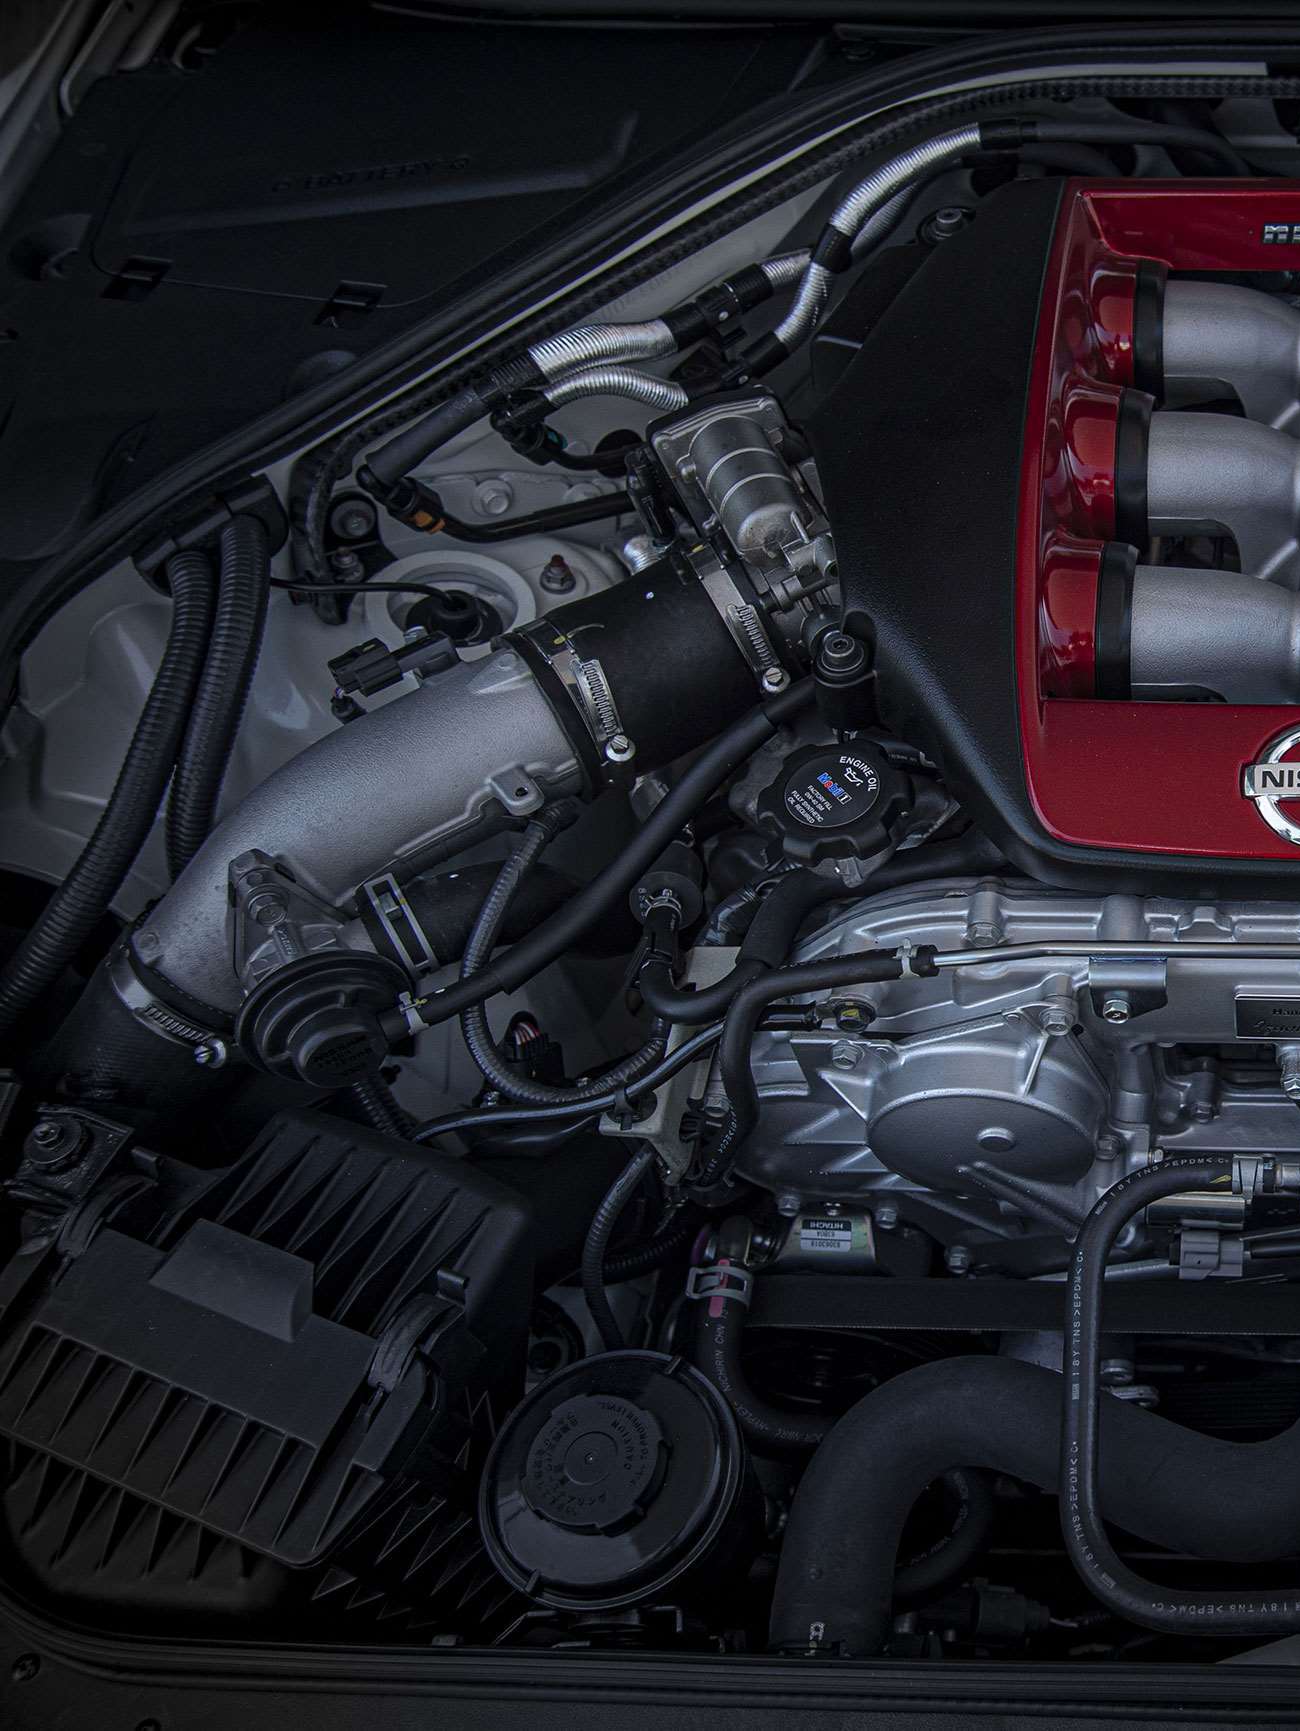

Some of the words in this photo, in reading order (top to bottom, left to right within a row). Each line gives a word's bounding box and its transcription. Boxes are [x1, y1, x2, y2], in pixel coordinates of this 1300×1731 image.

[816, 772, 846, 798] Mobil
[840, 755, 875, 778] ENGINE
[867, 777, 878, 792] OIL
[809, 1220, 844, 1229] HITACHI
